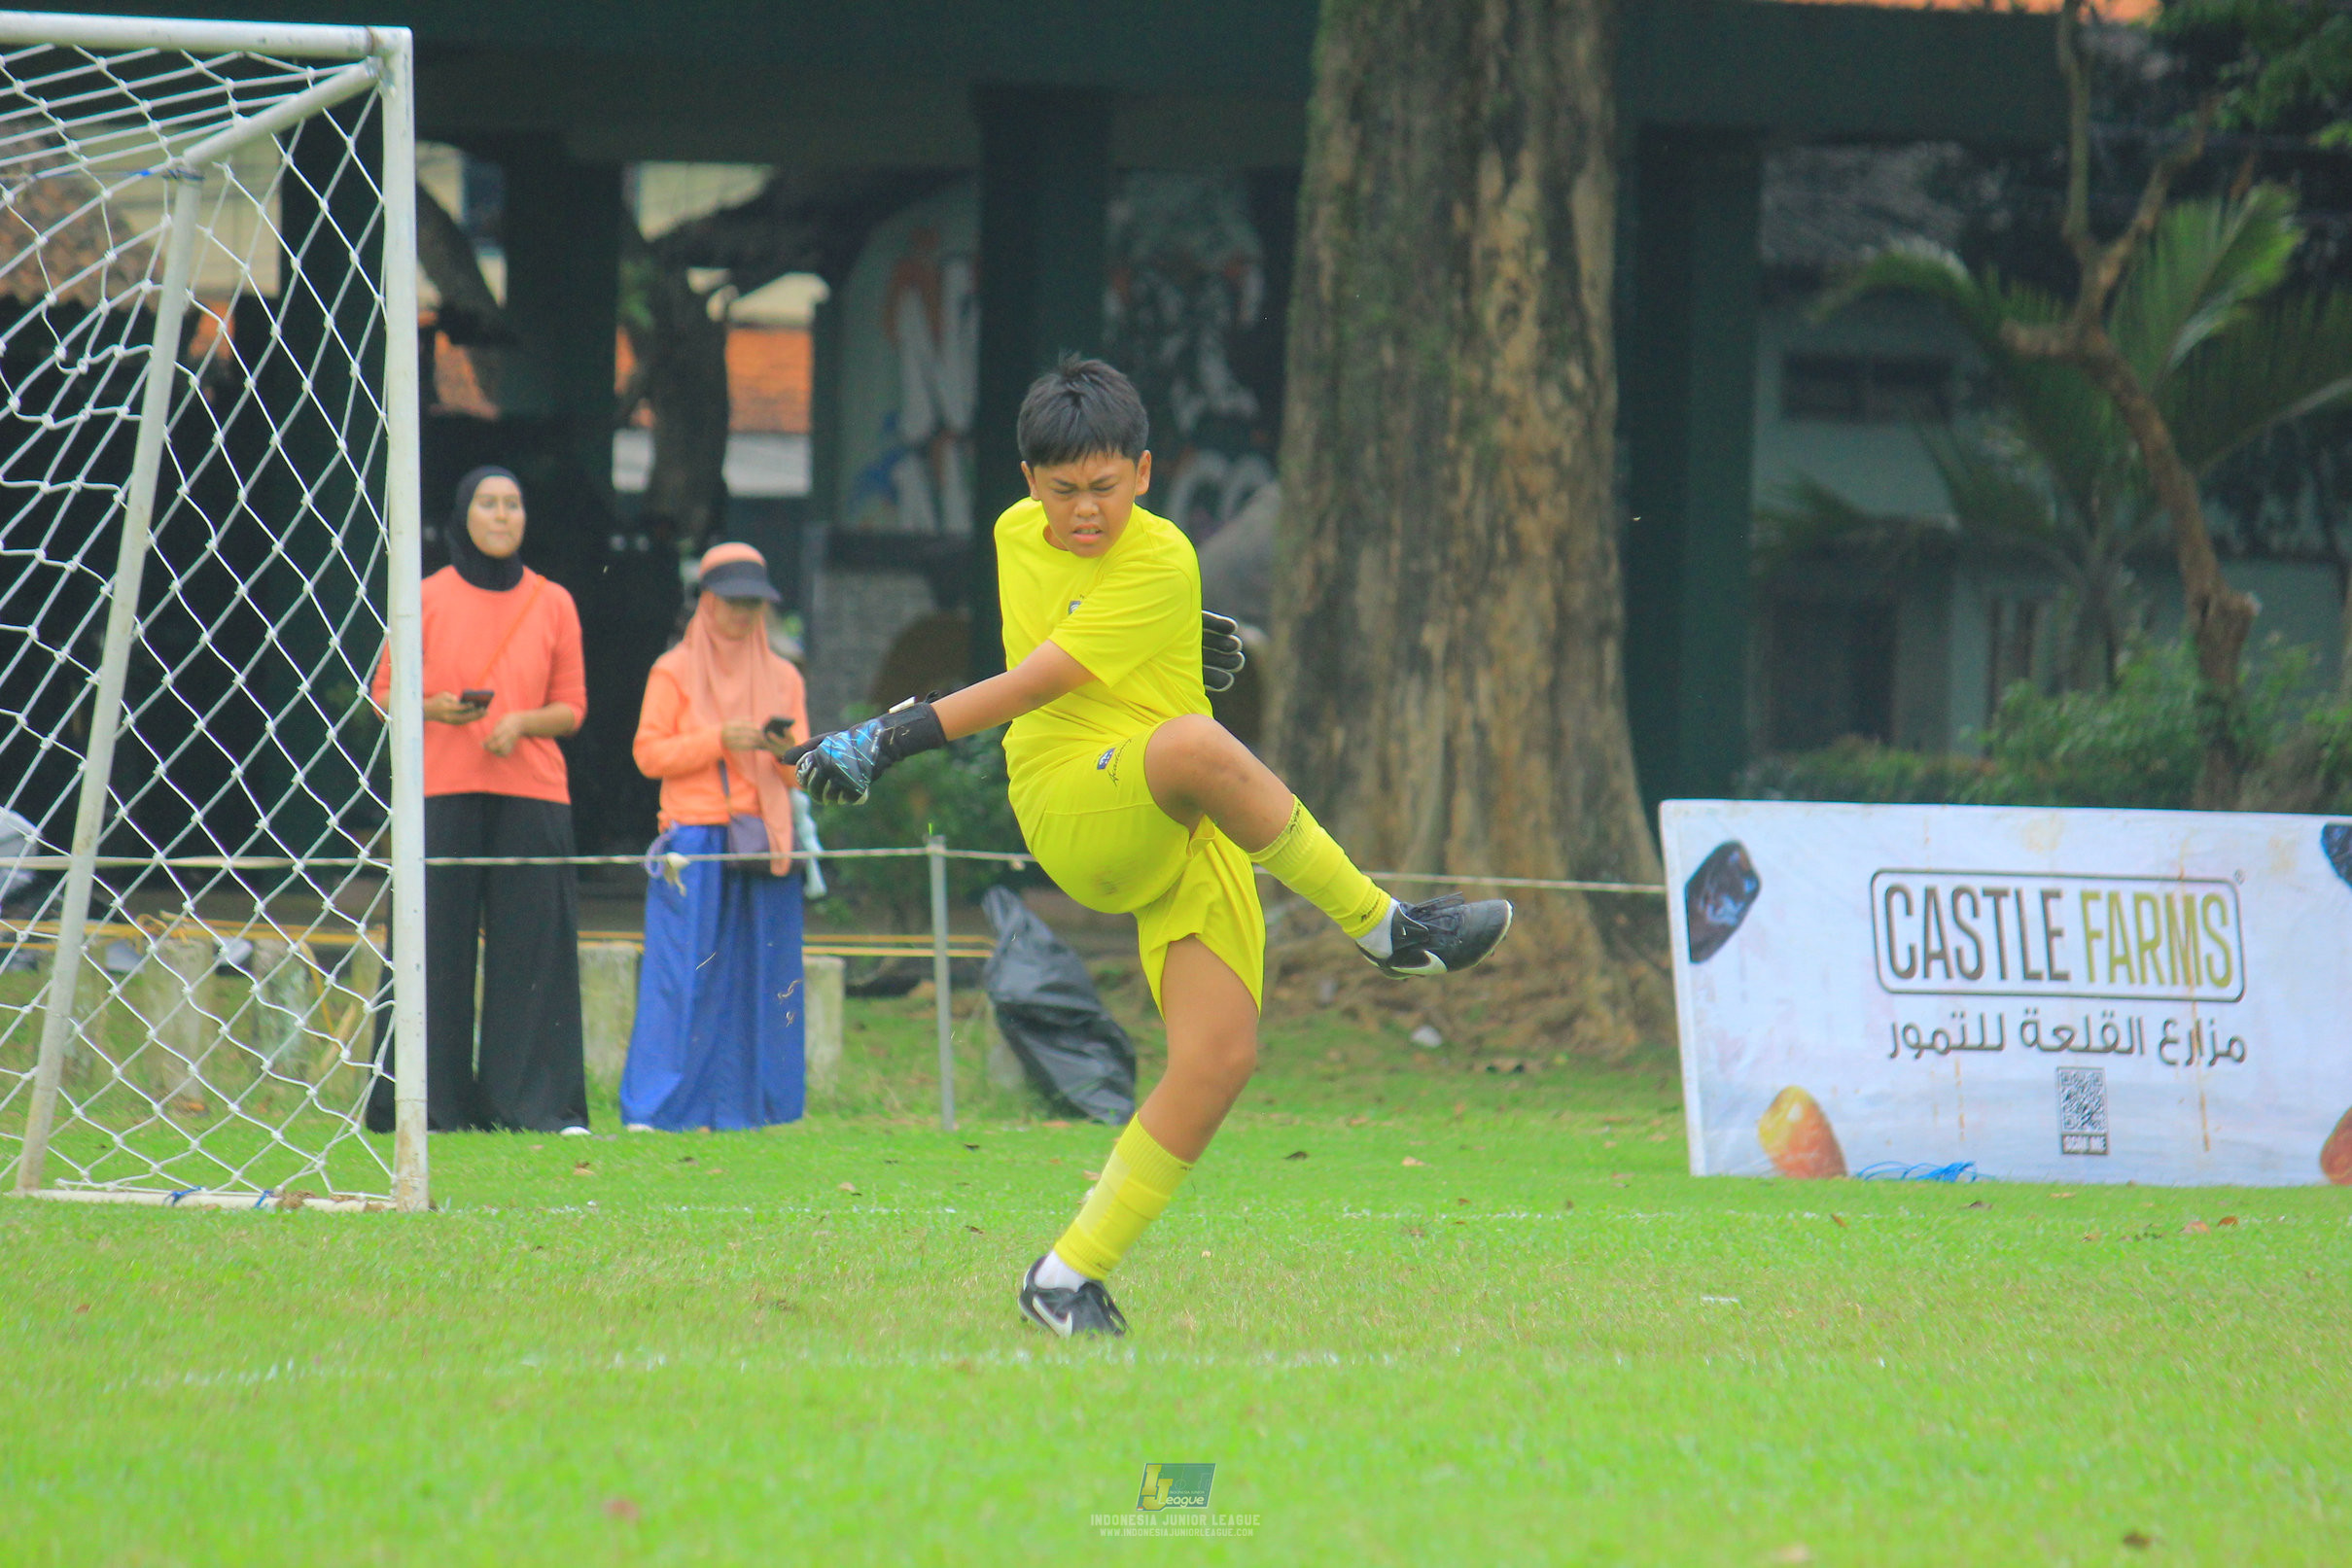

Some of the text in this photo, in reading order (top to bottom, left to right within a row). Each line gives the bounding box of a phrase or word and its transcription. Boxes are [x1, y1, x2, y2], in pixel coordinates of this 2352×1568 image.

[1884, 883, 2234, 989] CASTLE FARMS
[1888, 1007, 2248, 1067] مزارع القلعة للتمور
